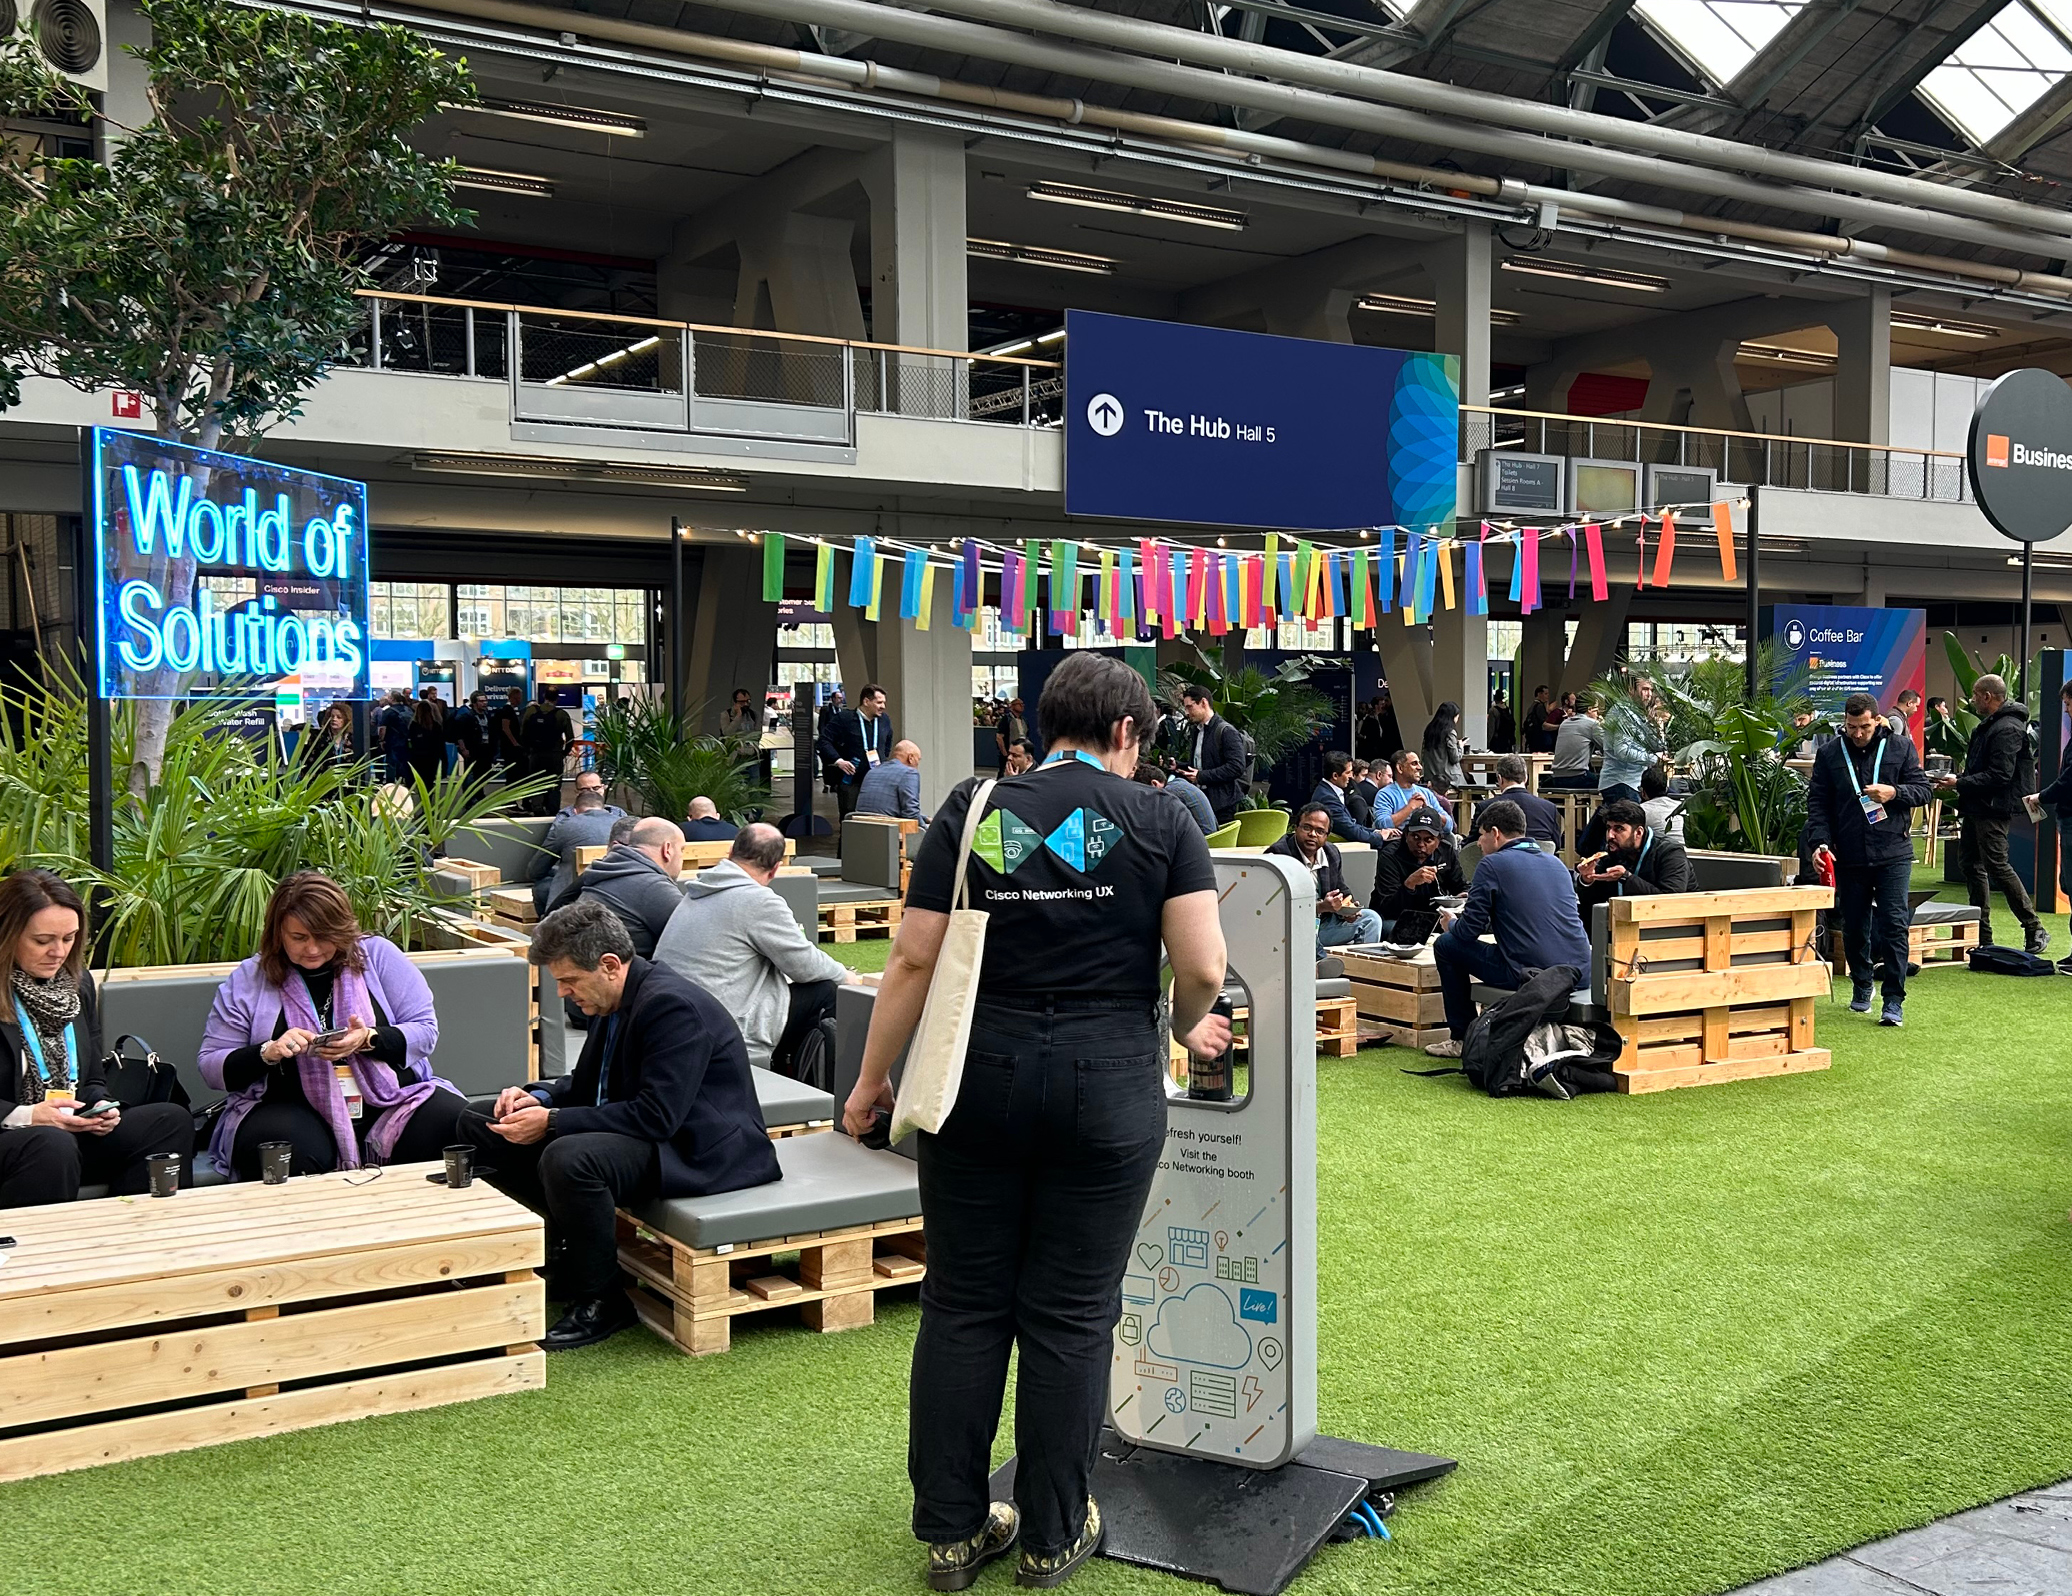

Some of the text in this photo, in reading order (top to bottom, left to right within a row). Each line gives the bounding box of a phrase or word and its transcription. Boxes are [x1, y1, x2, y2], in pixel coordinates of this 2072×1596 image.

[1144, 409, 1276, 443] The Hub Hall 5
[1501, 468, 1518, 476] Toilets
[1512, 461, 1523, 469] Hub
[1526, 462, 1536, 470] Hall
[1501, 476, 1519, 484] Session
[1520, 477, 1536, 486] Rooms
[121, 463, 354, 579] World of
[263, 583, 320, 595] Cisco Insider
[118, 579, 363, 677] Solutions
[1809, 628, 1864, 643] Coffee Bar
[244, 717, 265, 726] Refill
[985, 885, 1115, 900] Cisco Networking UX
[1198, 1132, 1242, 1145] yourself!
[1180, 1148, 1218, 1162] Visit the
[1172, 1161, 1225, 1178] Networking
[1227, 1167, 1255, 1180] booth
[1243, 1294, 1274, 1315] Live!
